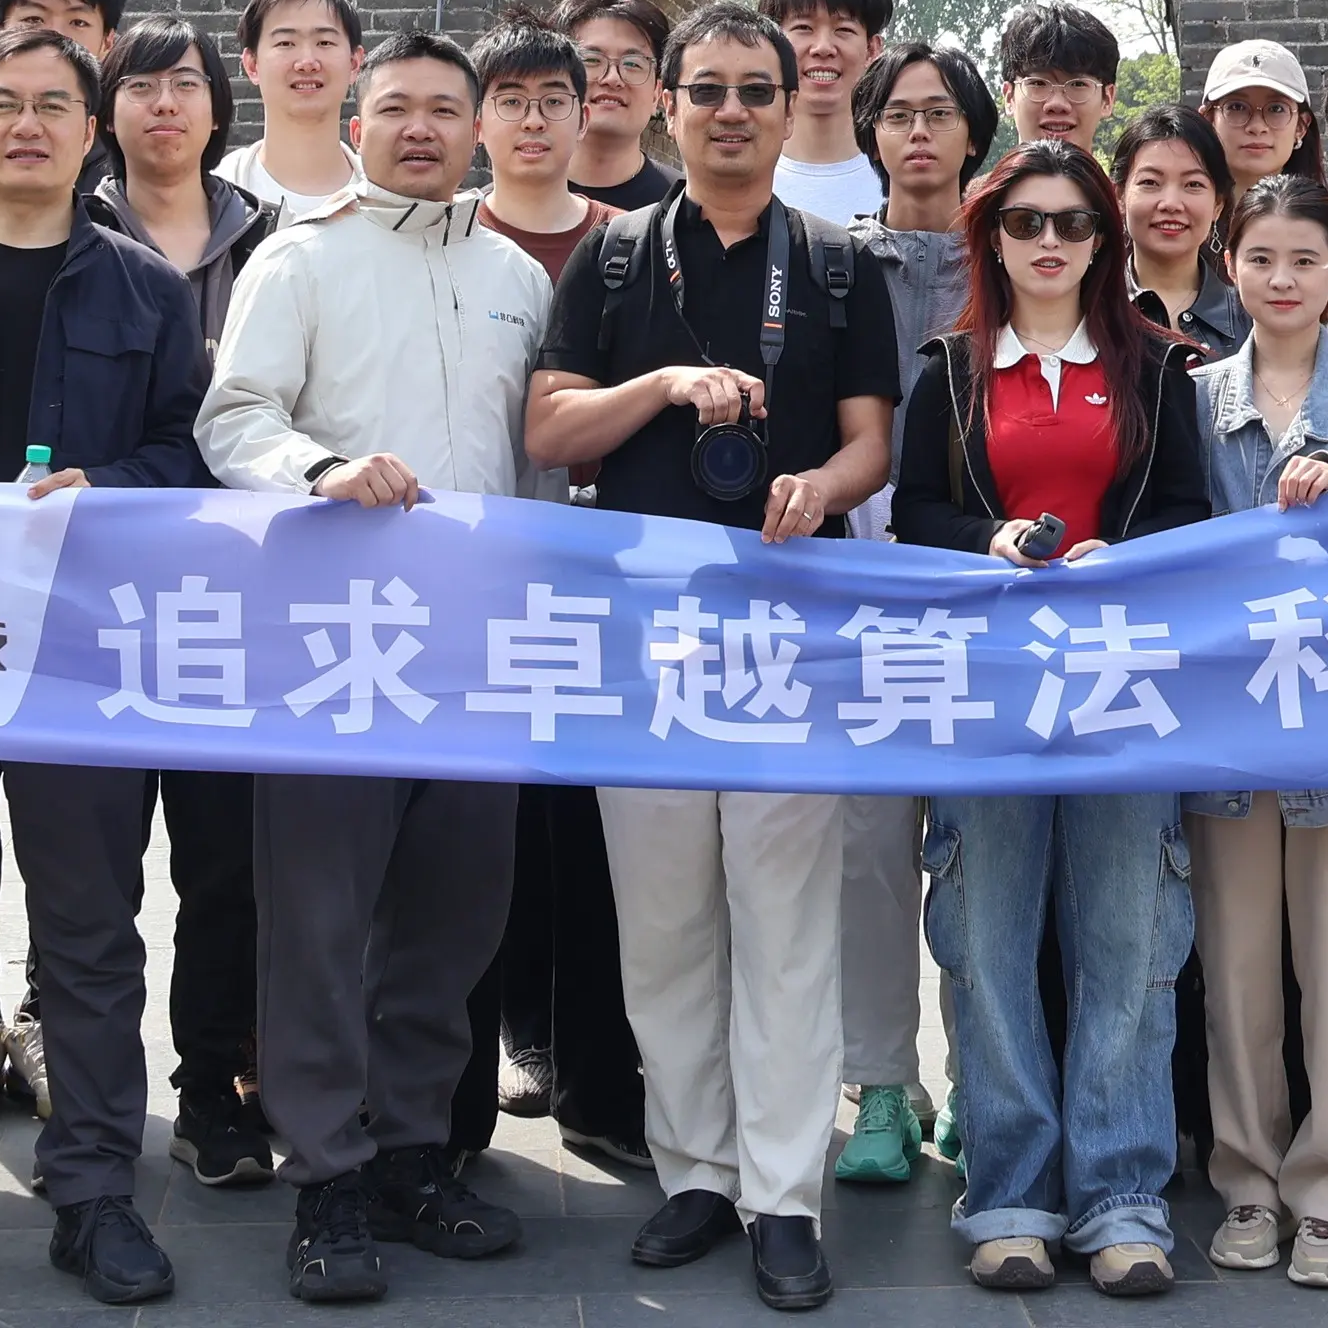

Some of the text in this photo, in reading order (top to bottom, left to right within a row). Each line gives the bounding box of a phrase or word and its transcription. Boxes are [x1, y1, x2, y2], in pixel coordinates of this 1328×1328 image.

[768, 264, 782, 317] SONY
[97, 575, 1181, 745] 追求卓越算法
